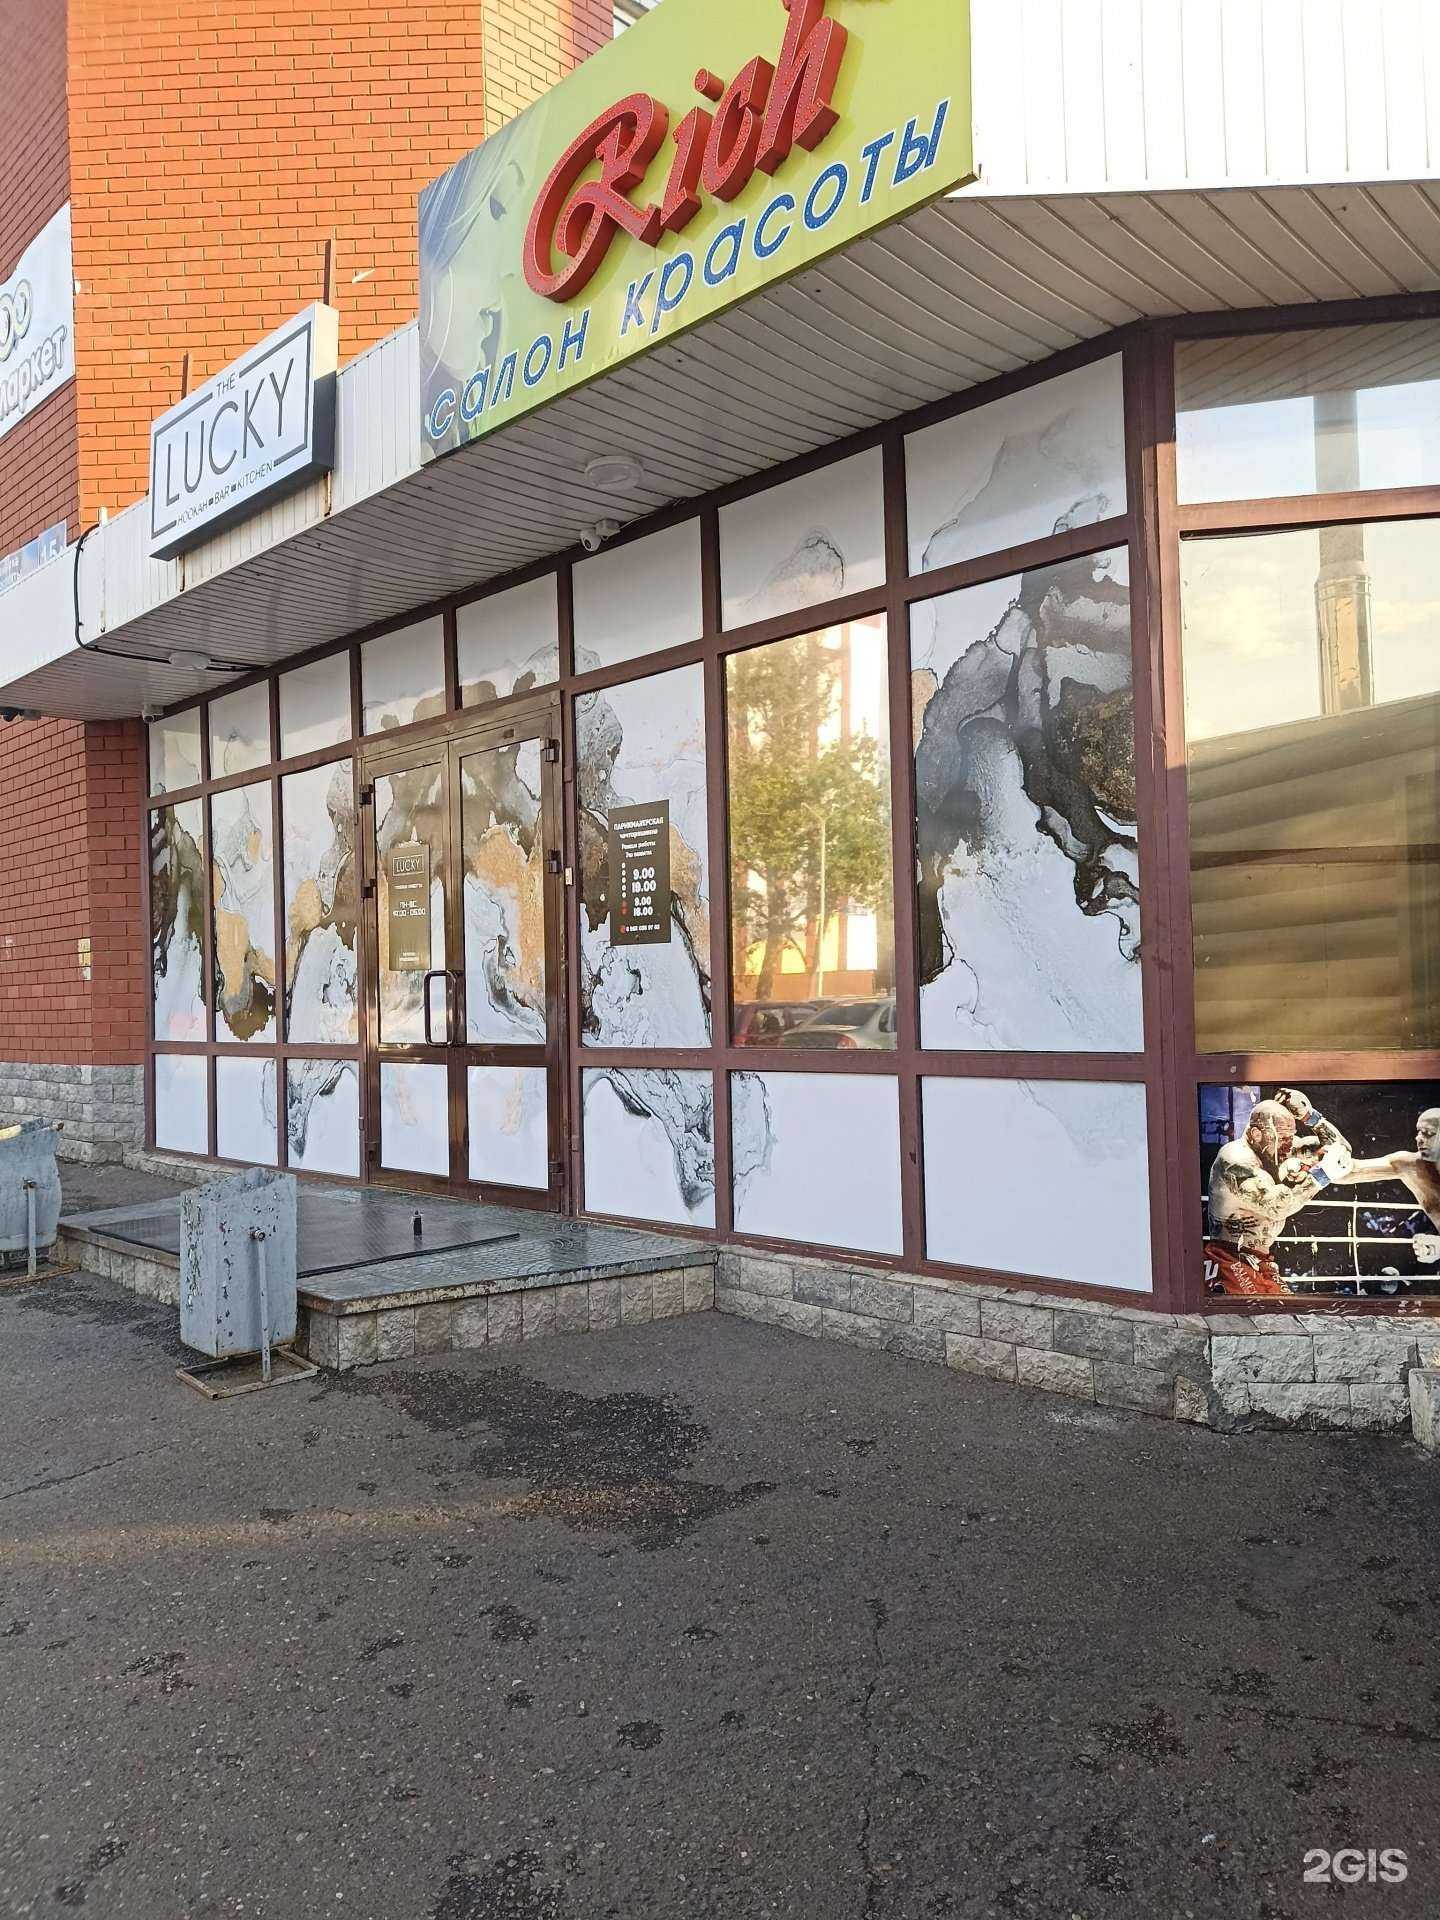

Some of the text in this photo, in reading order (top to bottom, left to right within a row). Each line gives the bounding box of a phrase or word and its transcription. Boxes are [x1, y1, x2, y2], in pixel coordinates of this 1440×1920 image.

[522, 0, 848, 303] Rich
[428, 97, 951, 440] салон красоты
[216, 372, 237, 397] THE
[166, 357, 294, 507] LUCKY
[176, 459, 274, 526] HOOKAH BAR KITCHEN
[396, 858, 420, 873] LUCKY
[632, 866, 656, 881] 9.00
[634, 896, 652, 907] 9.00
